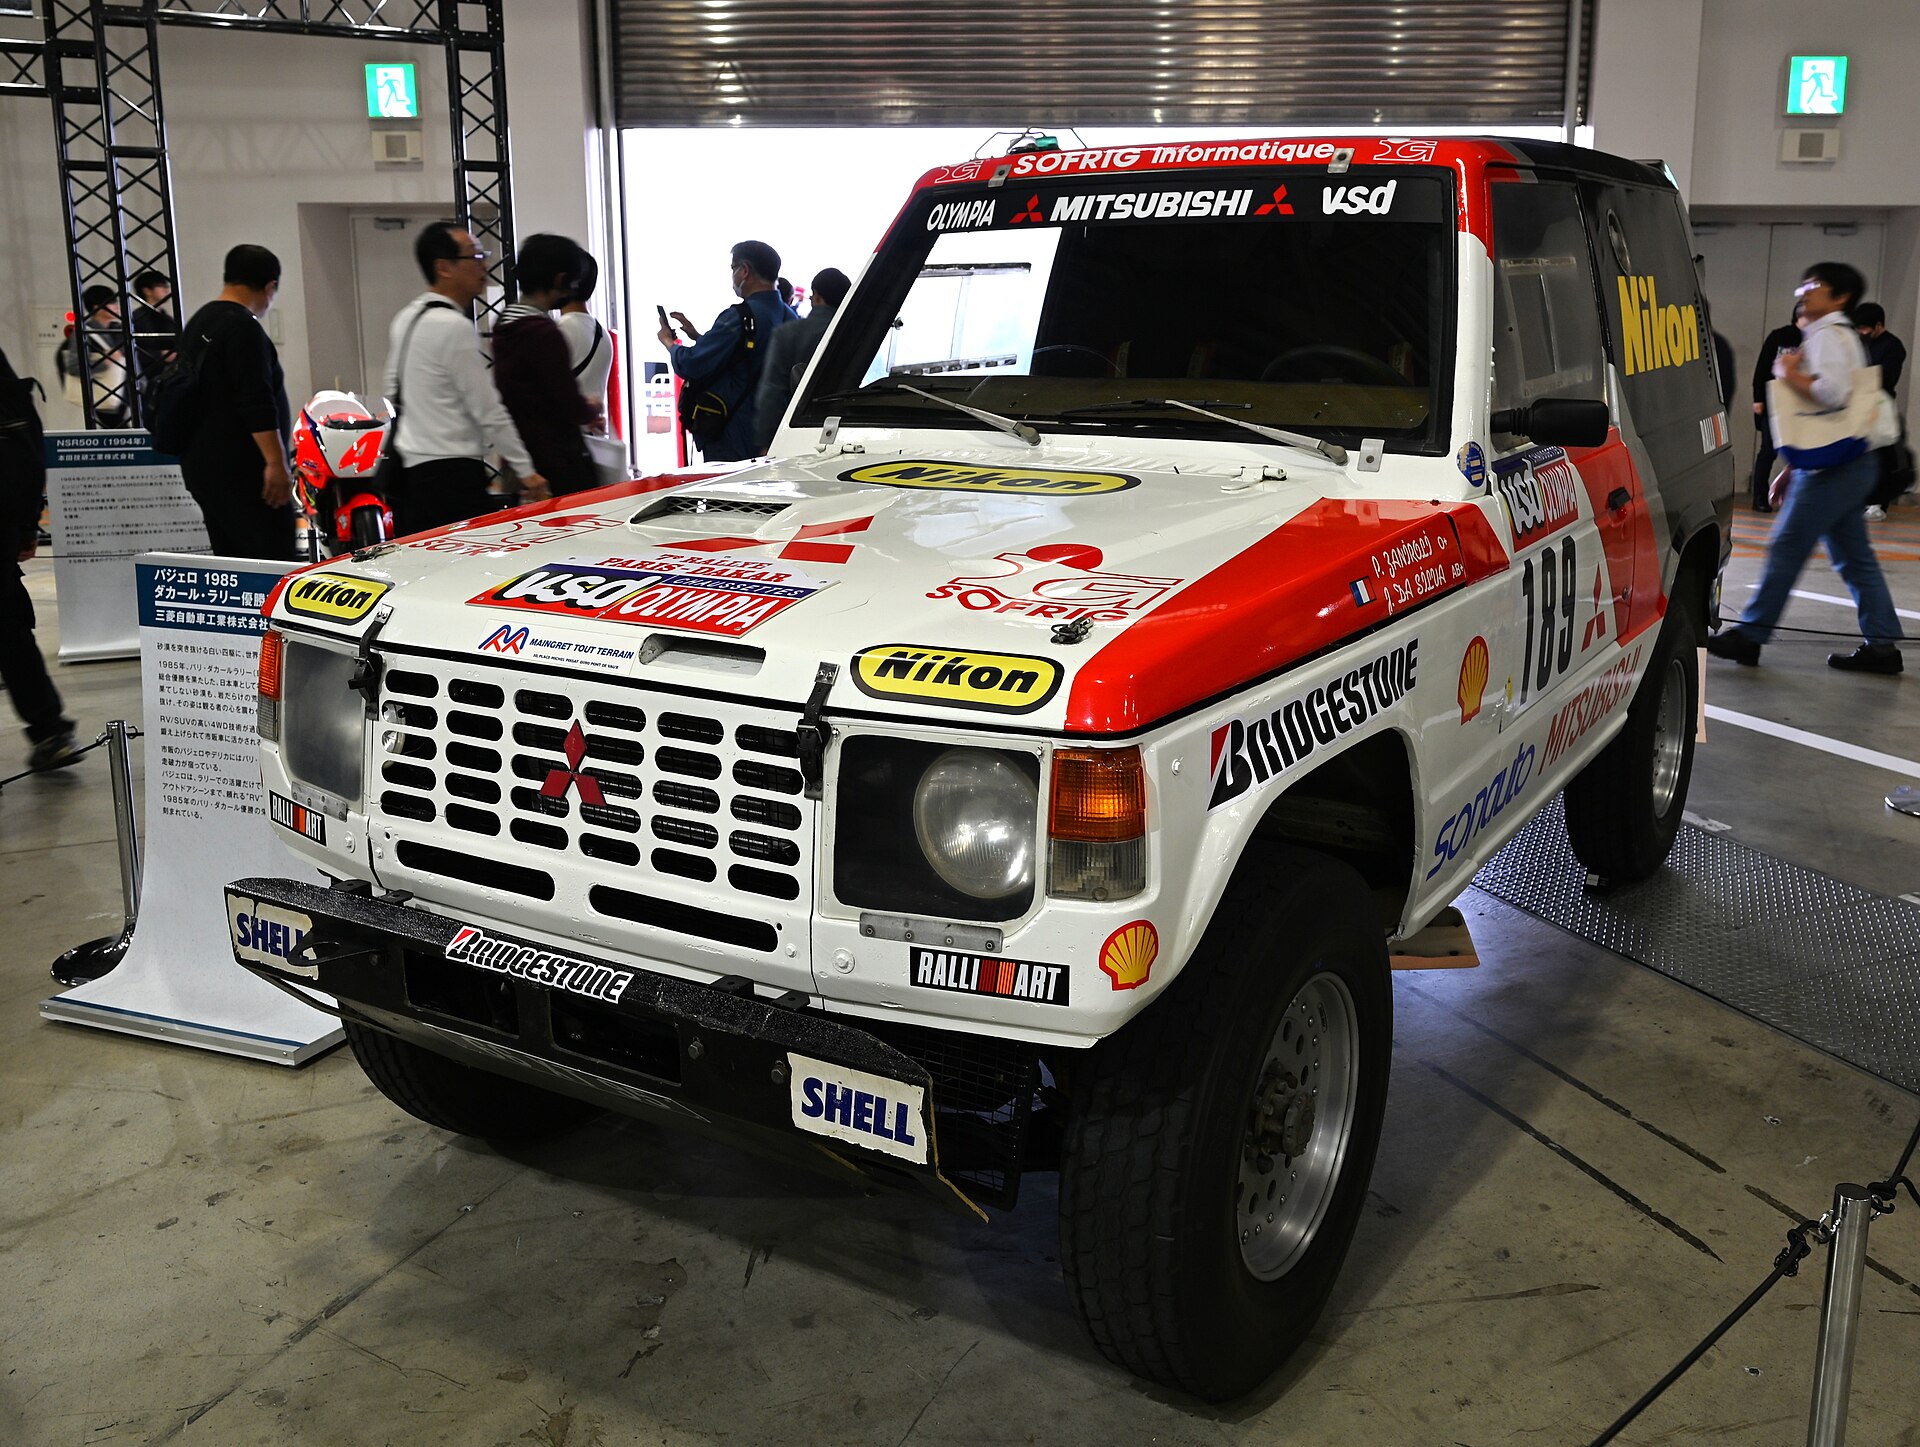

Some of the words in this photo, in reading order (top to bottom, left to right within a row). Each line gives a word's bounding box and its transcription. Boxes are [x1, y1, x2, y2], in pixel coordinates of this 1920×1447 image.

[1013, 149, 1141, 174] SOFRIG
[1151, 141, 1335, 164] Informatique
[926, 199, 997, 231] OLYMPIA
[1050, 188, 1254, 222] MITSUBISHI
[1322, 179, 1398, 215] vsd
[1617, 275, 1700, 376] Nikon
[338, 430, 384, 474] 4
[873, 465, 1102, 490] Nikon
[154, 568, 198, 584] パジェロ
[204, 572, 239, 588] 1985
[678, 555, 773, 570] RALLYE
[154, 584, 269, 607] ダカール・ラリー優勝
[294, 579, 373, 609] Nikon
[502, 571, 664, 610] vsd
[619, 587, 780, 628] OLYMPIA
[673, 576, 804, 597] CHAUSSETTES
[925, 583, 1129, 622] SOFRIG
[1392, 578, 1414, 604] DA
[155, 609, 268, 631] 三菱自動車工業株式会社
[1520, 535, 1576, 706] 189
[529, 638, 573, 652] MAINGRET
[573, 643, 596, 655] TOUT
[596, 647, 635, 660] TERRAIN
[873, 650, 1040, 694] Nikon
[1207, 637, 1419, 812] BRIDGESTONE
[1537, 644, 1642, 777] MITSUBISHI
[271, 792, 295, 830] RALLI
[304, 812, 325, 842] ART
[1425, 742, 1536, 881] sonauto
[447, 927, 634, 1003] BRIDGESTONE
[917, 951, 981, 991] RALLI
[1013, 962, 1062, 1001] ART
[800, 1077, 916, 1147] SHELL
